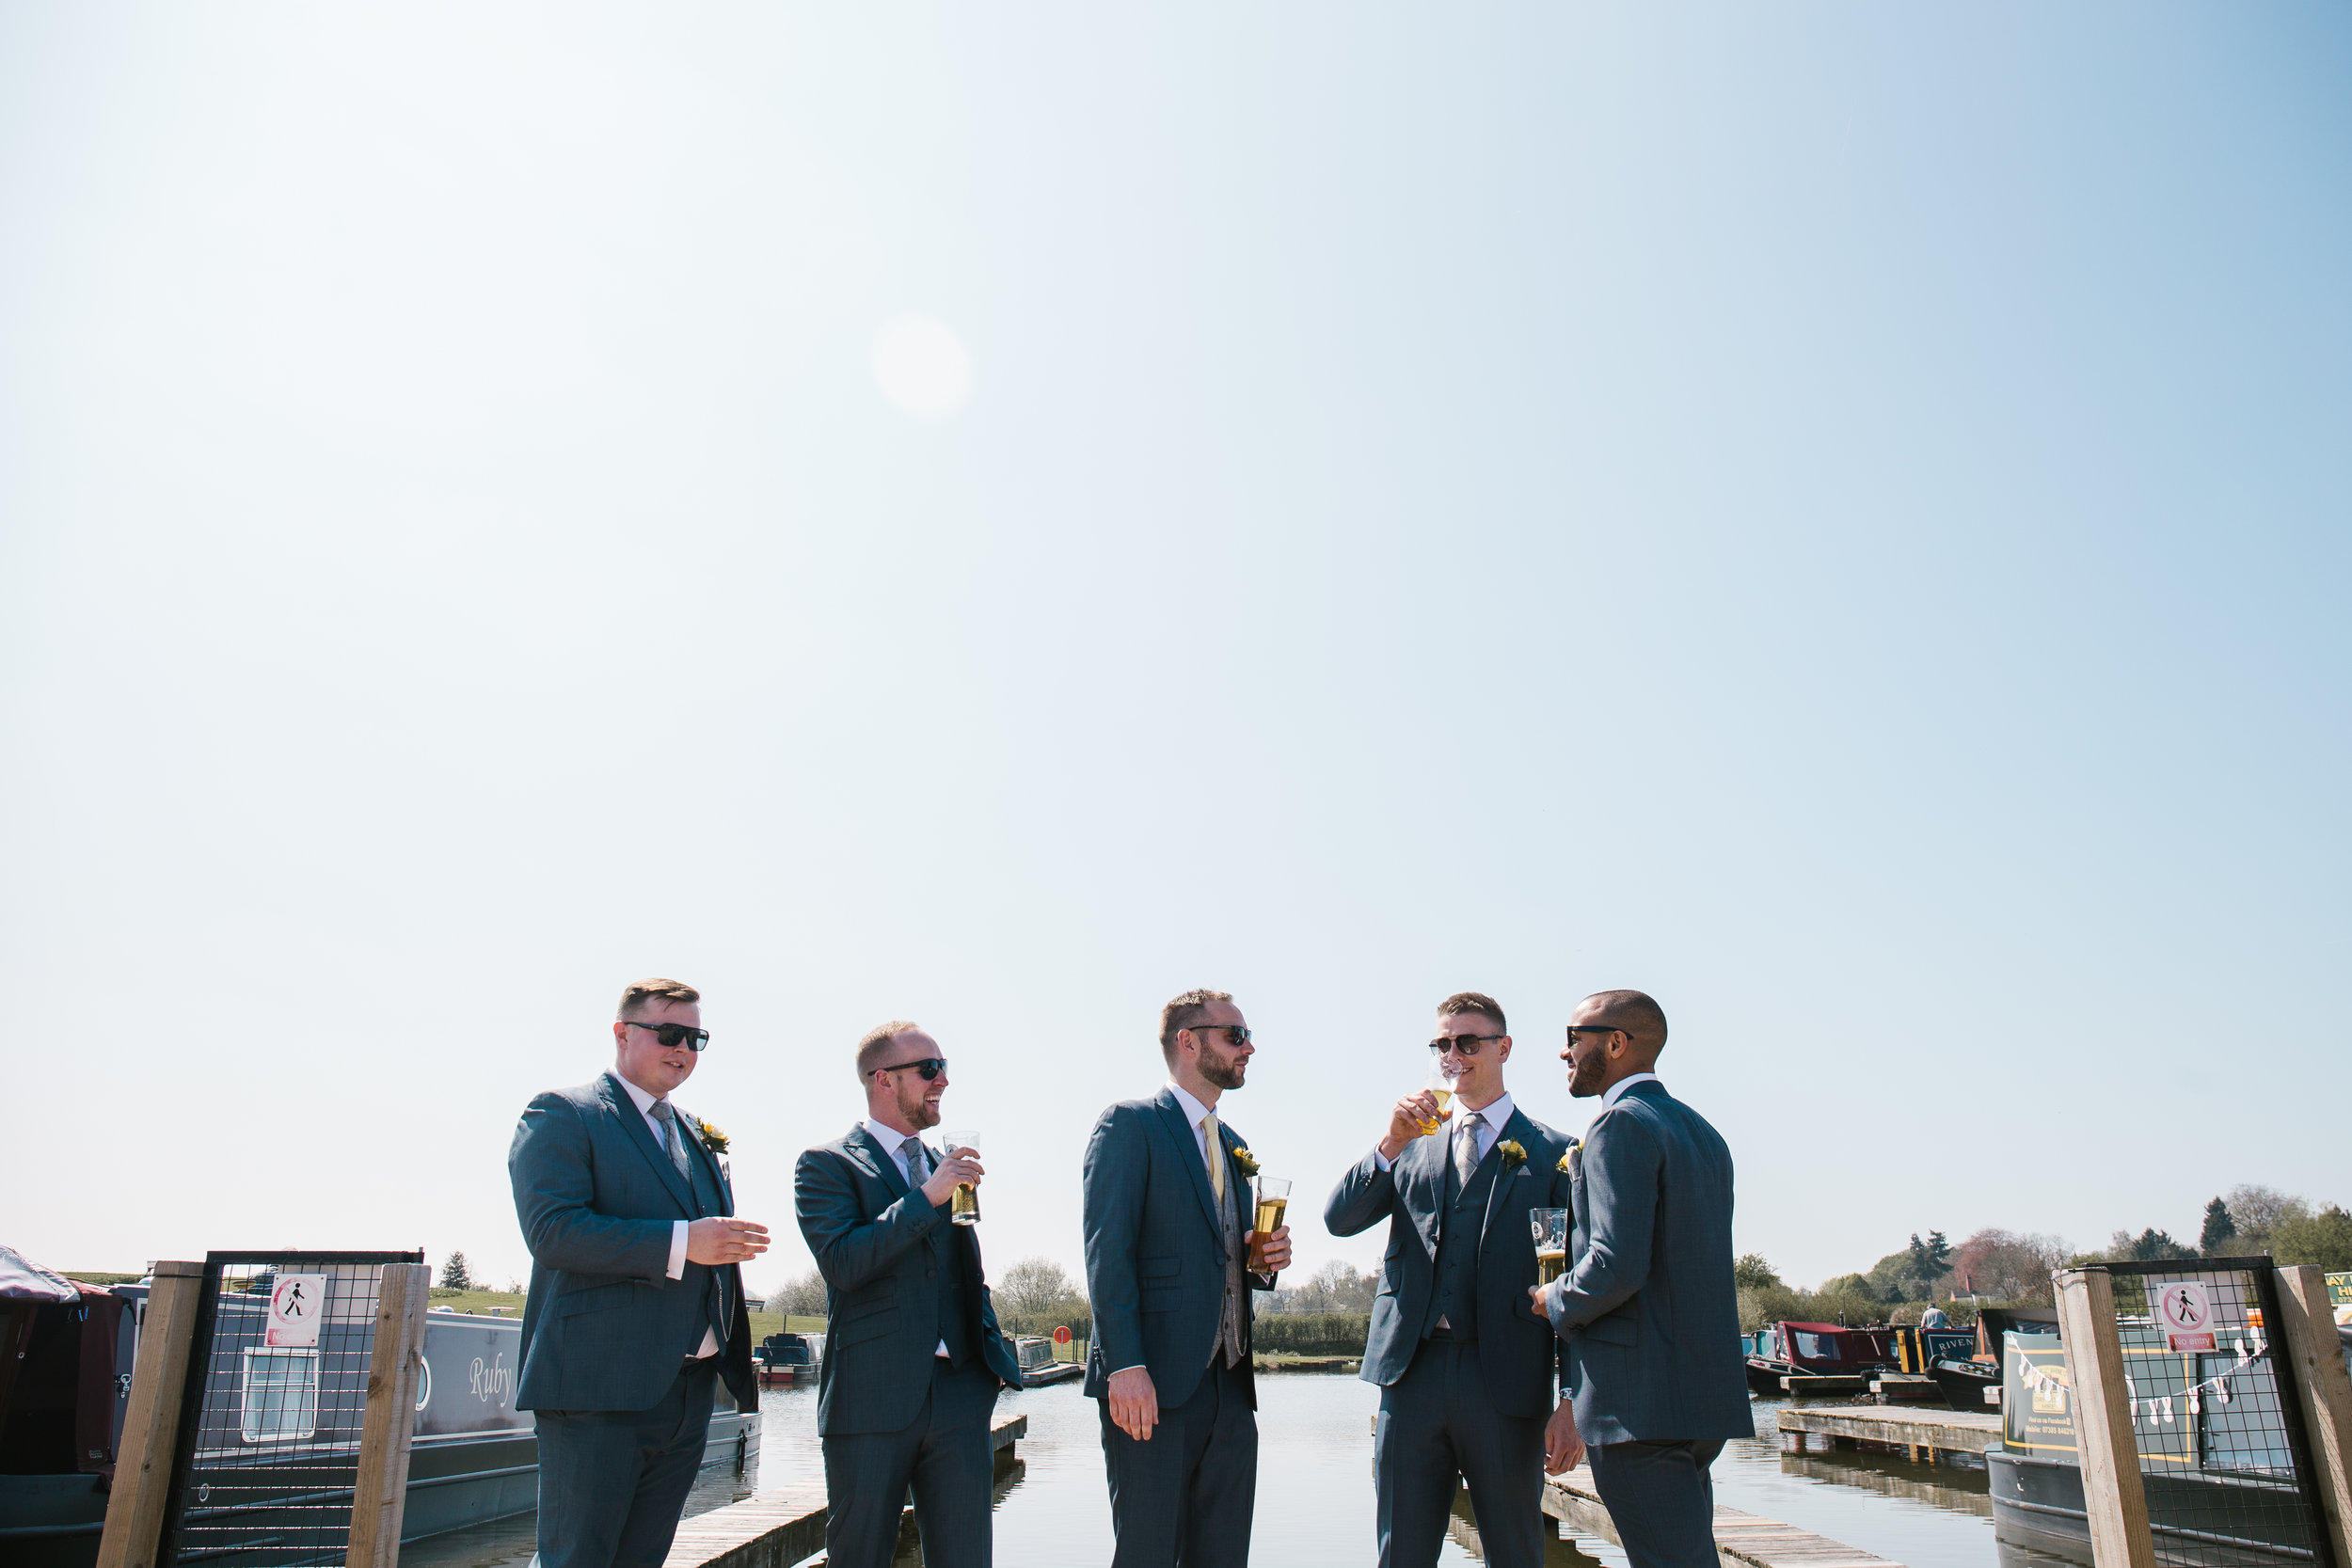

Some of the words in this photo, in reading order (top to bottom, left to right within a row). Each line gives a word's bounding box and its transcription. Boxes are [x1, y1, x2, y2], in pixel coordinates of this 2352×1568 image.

[2174, 1338, 2186, 1346] No
[2189, 1337, 2210, 1347] entry
[469, 1352, 511, 1407] Ruby
